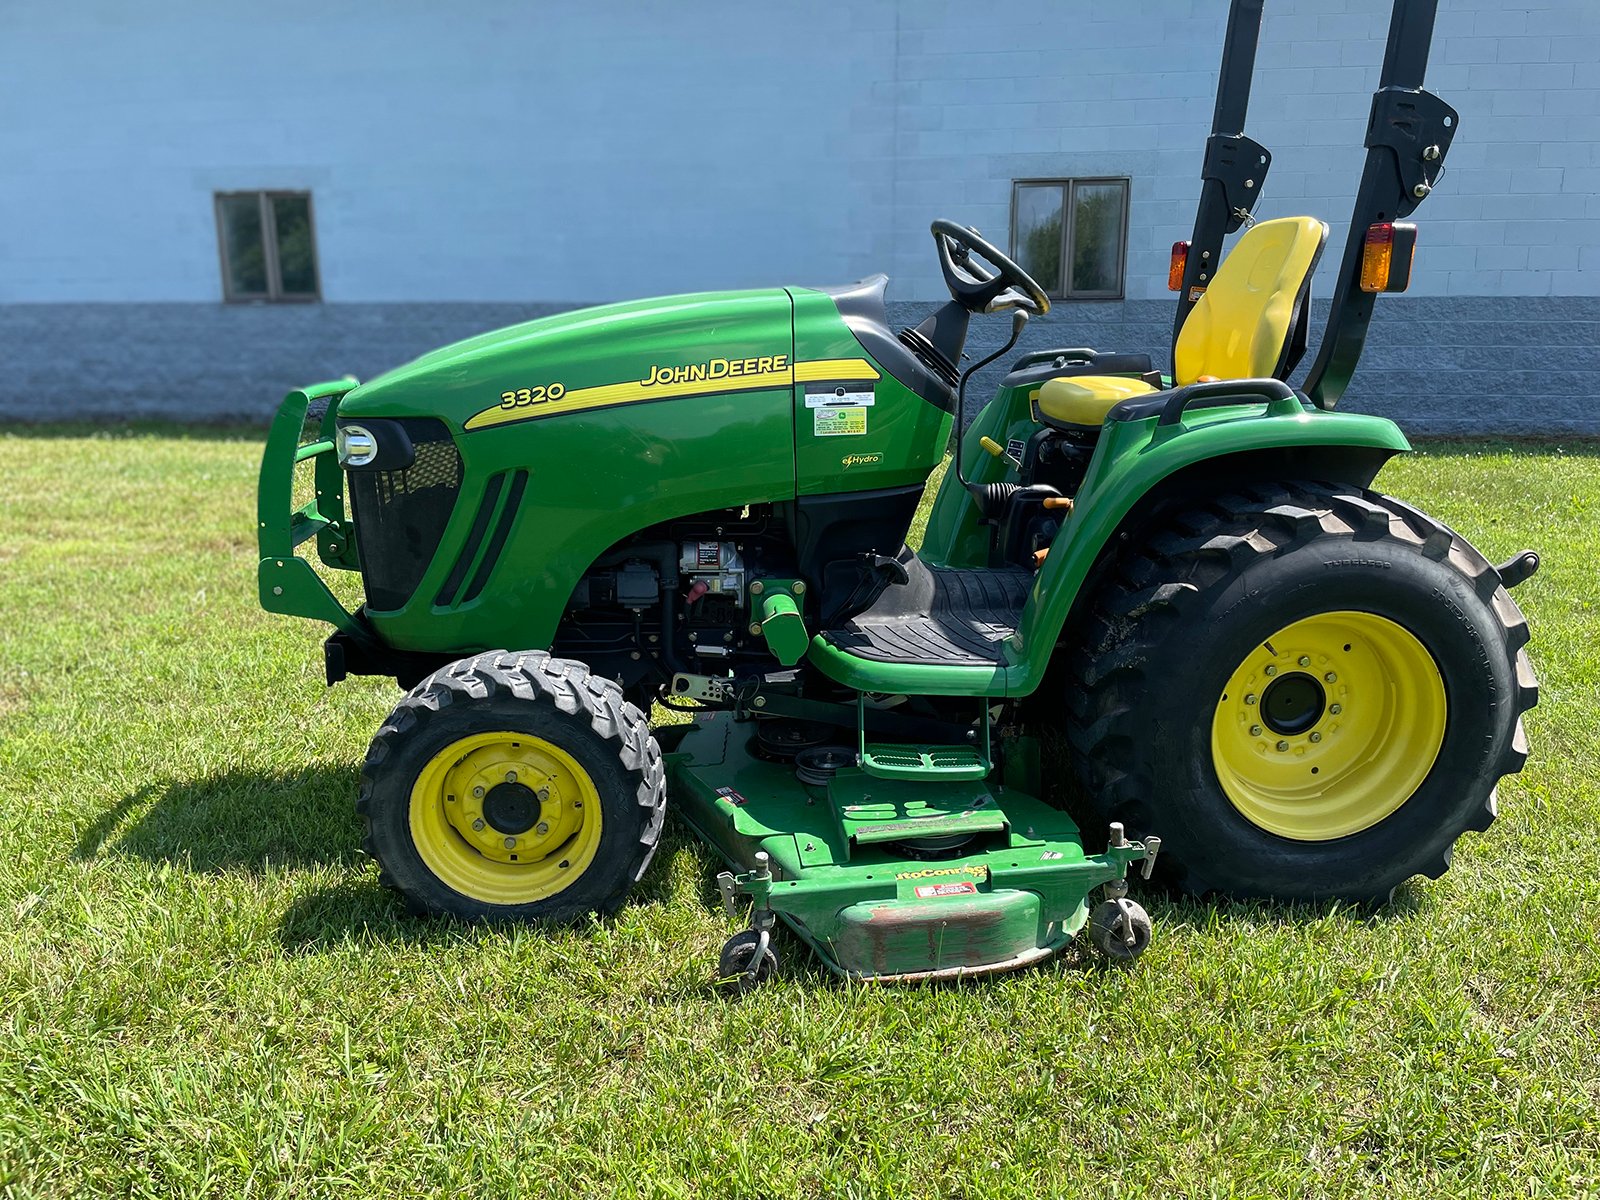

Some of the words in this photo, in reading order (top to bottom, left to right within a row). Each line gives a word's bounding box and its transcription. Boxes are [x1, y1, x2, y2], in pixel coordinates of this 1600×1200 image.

[641, 364, 706, 386] JOHN
[708, 355, 788, 378] DEERE
[501, 382, 566, 409] 3320
